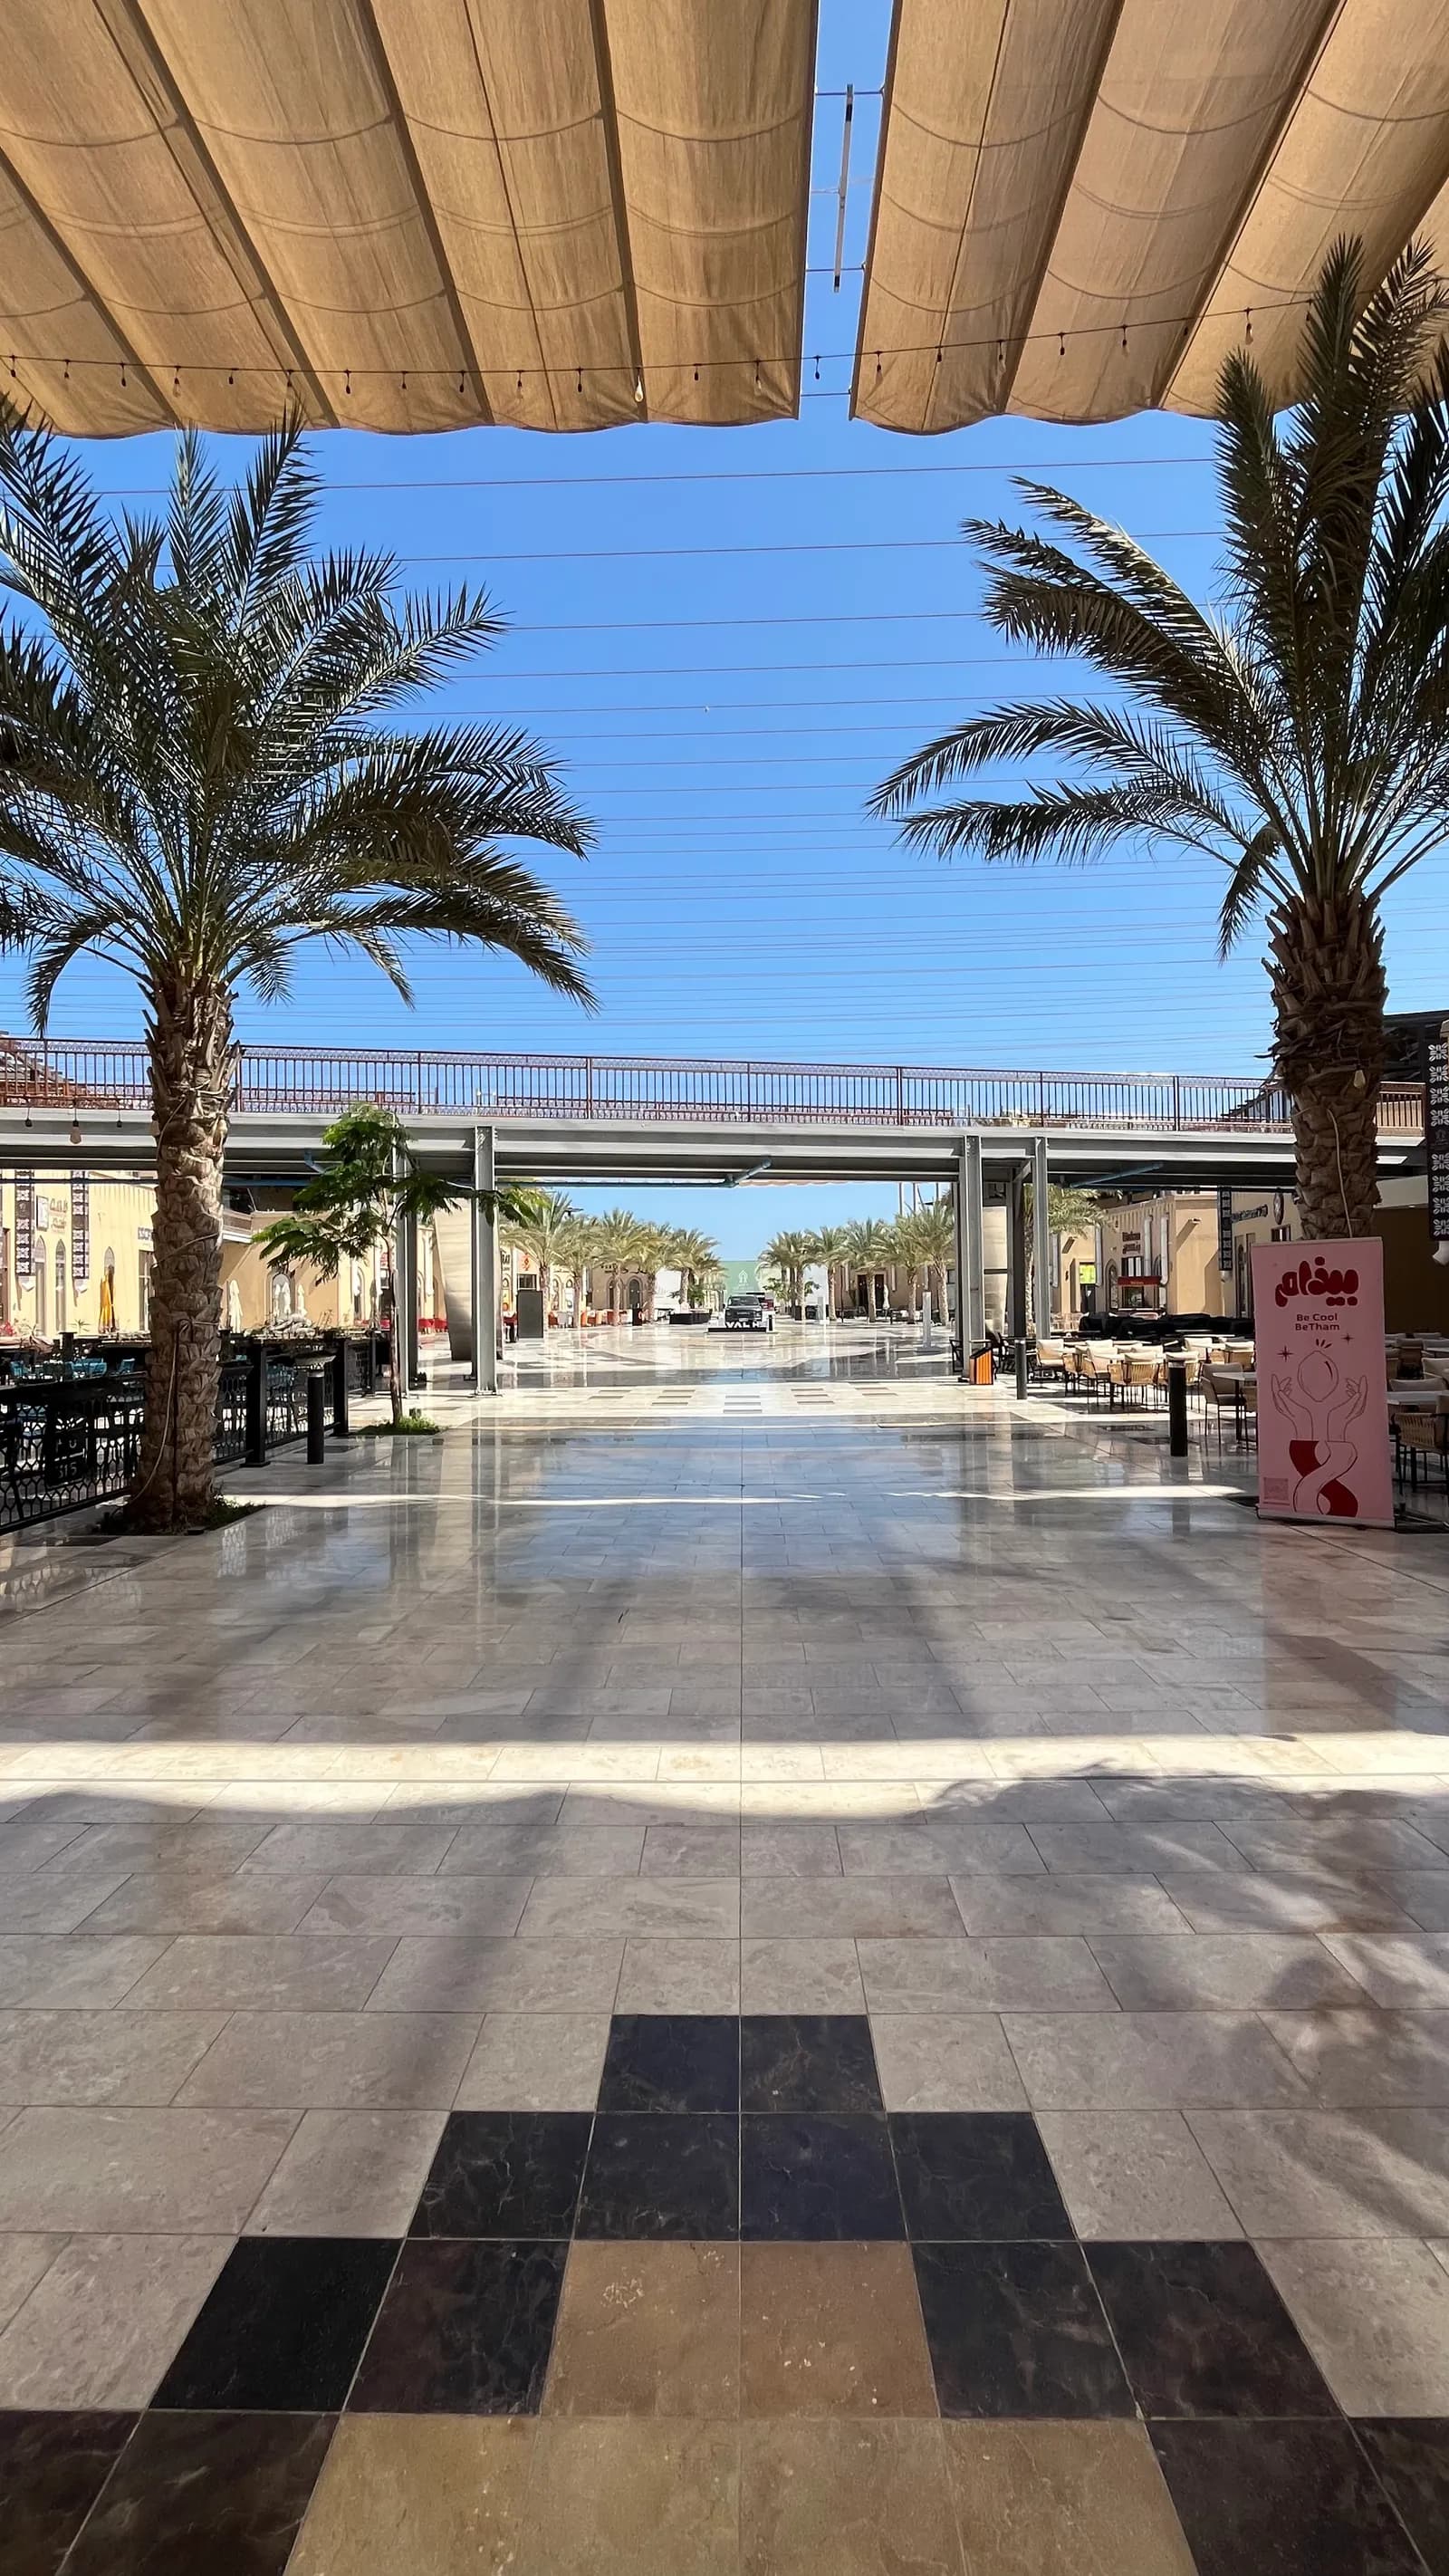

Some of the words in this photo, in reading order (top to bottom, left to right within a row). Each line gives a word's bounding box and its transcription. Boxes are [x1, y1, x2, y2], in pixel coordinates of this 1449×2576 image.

[1275, 1256, 1359, 1307] بيذام
[1296, 1313, 1310, 1322] Be
[1312, 1312, 1338, 1322] Cool
[1295, 1323, 1340, 1331] BeTham
